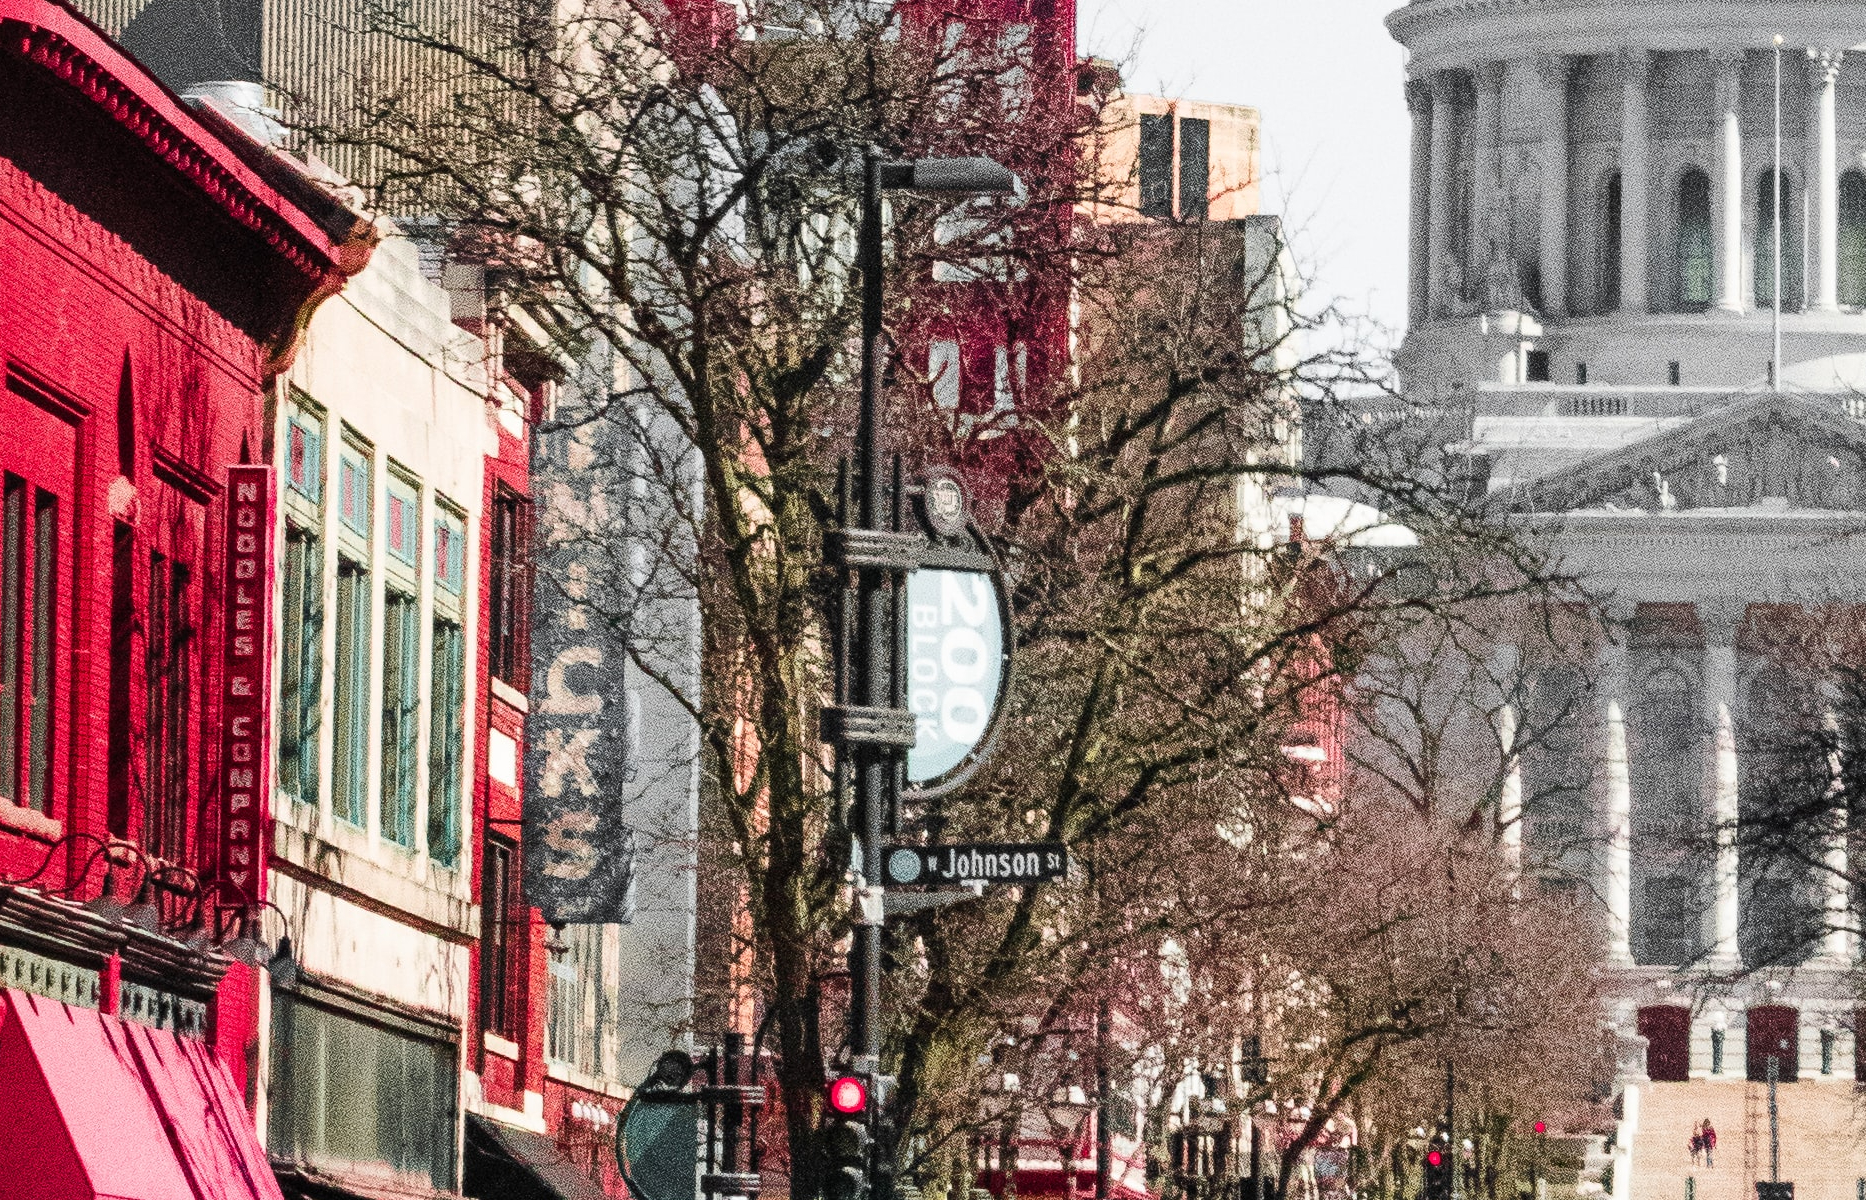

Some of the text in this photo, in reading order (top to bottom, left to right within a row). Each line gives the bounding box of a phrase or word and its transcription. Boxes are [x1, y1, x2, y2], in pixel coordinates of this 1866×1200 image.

[228, 481, 258, 887] NOODLES & COMPANY
[912, 604, 940, 742] BLOCK
[940, 569, 990, 744] 200
[941, 847, 1041, 880] Johnson
